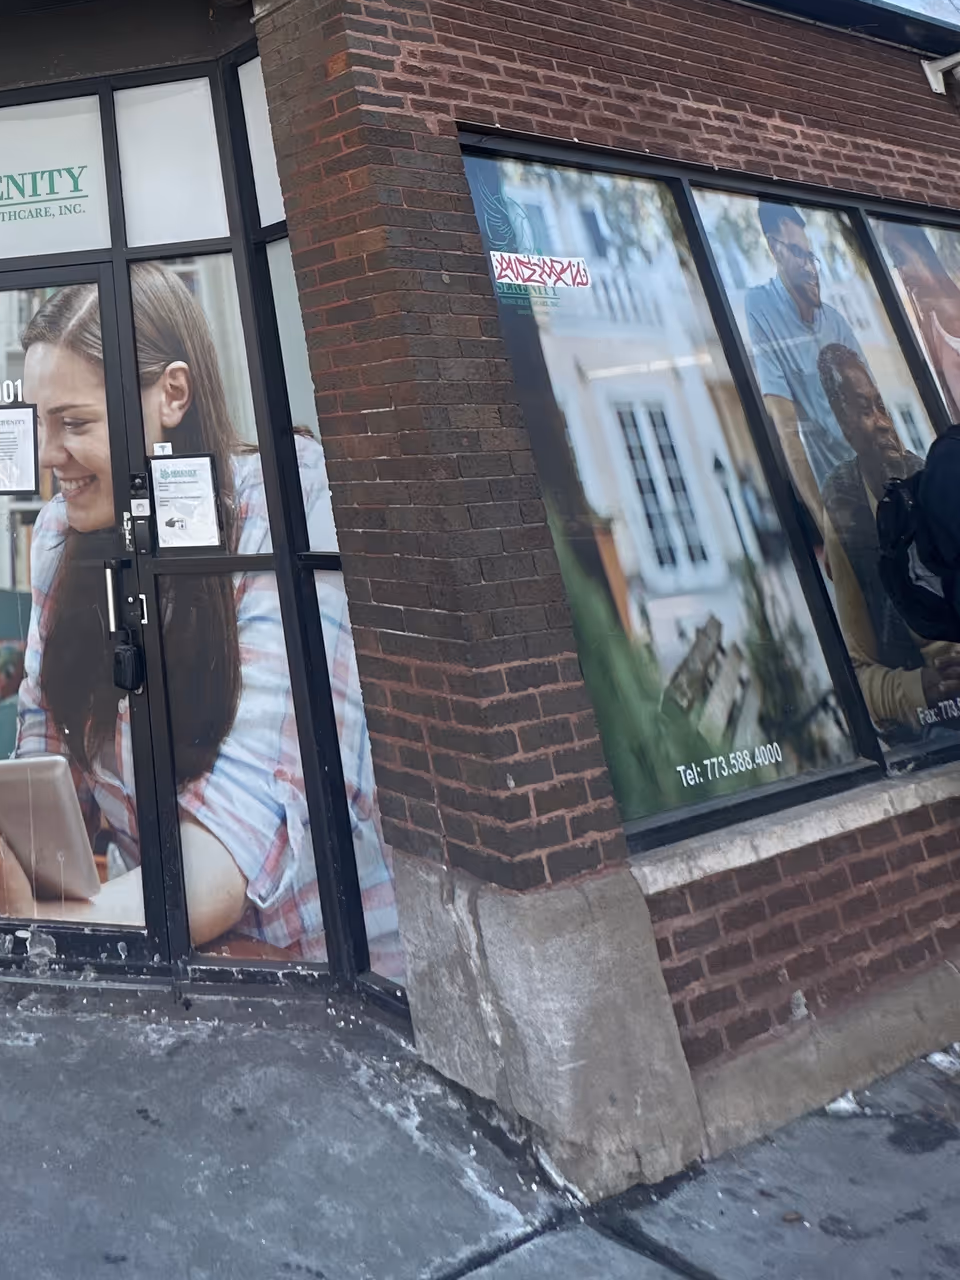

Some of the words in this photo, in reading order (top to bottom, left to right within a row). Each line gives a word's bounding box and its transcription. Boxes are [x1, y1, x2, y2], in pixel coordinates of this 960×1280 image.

[58, 203, 86, 216] INC.
[917, 707, 941, 725] Fax:
[677, 764, 704, 787] Tel:
[703, 742, 782, 781] 773.588.4000
